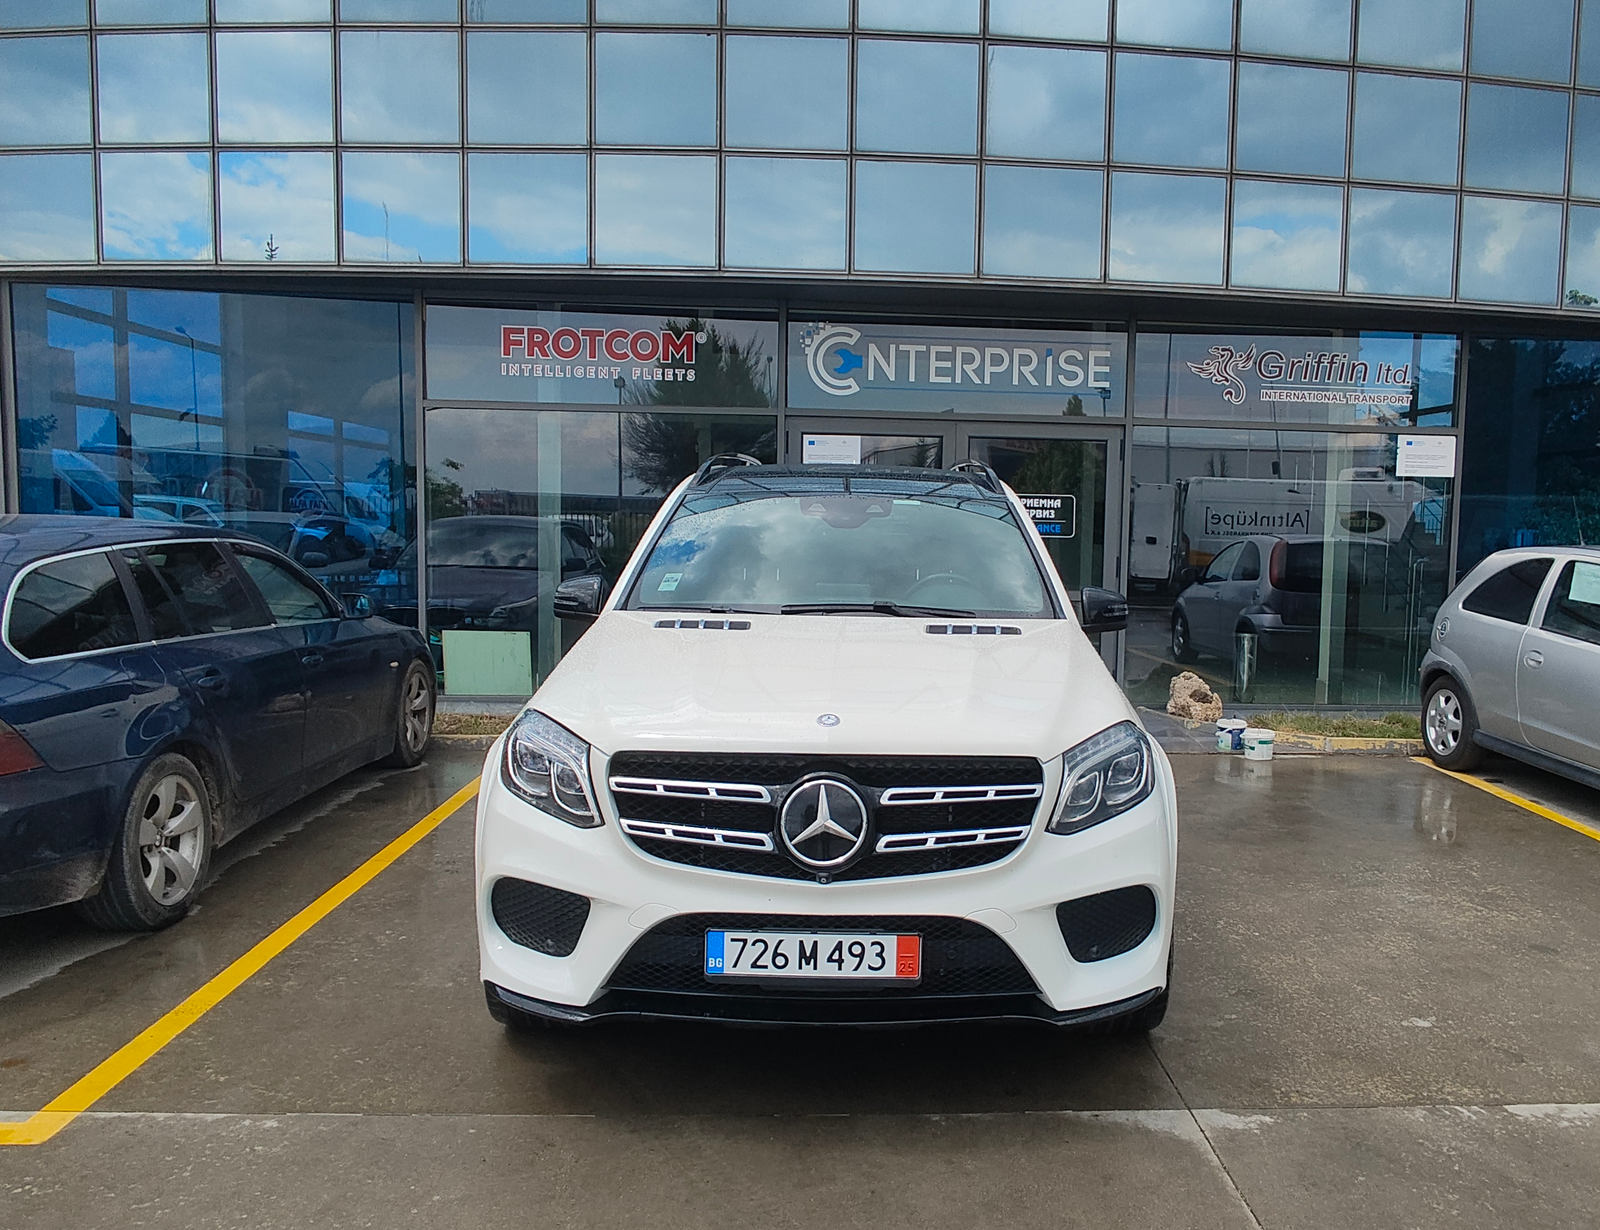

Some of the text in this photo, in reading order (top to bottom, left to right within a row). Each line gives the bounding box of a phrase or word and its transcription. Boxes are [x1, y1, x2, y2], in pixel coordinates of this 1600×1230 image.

[500, 324, 696, 364] FROTCOM
[501, 362, 696, 382] INTELLIGENT FLEETS
[1256, 350, 1412, 386] Griffin ltd.
[1260, 389, 1413, 406] INTERNATIONAL TRANSPORT
[1020, 498, 1062, 508] РИЕМНА
[708, 957, 723, 968] BG
[729, 938, 887, 972] 726 M 493
[899, 962, 915, 973] 25
